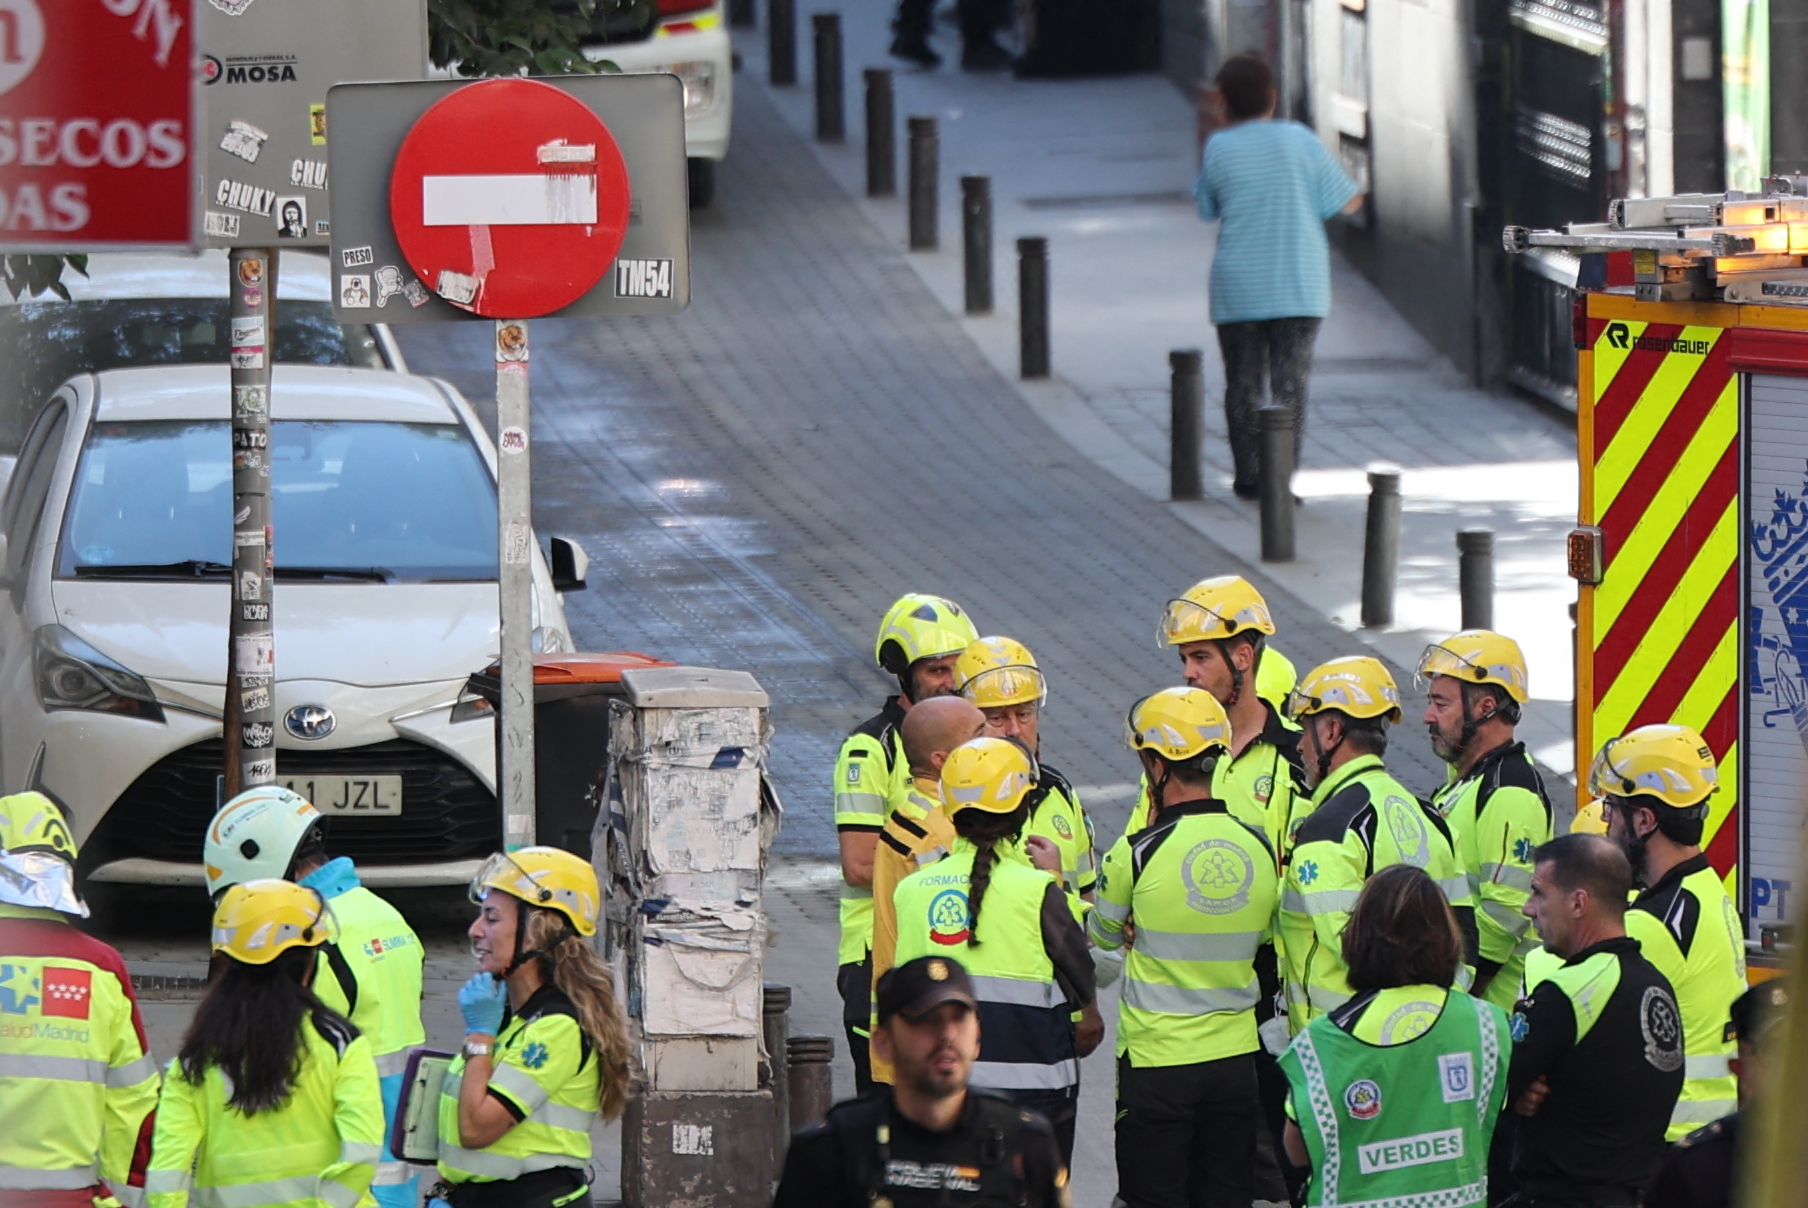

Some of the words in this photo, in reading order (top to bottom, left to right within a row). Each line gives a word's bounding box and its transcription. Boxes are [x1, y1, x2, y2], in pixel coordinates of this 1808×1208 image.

[102, 0, 184, 68] N
[226, 65, 298, 84] MOSA
[291, 159, 328, 191] CHU
[0, 182, 91, 232] AS
[217, 179, 276, 216] CHUKY
[344, 248, 372, 265] PRESO
[618, 259, 670, 297] TM54
[1632, 333, 1710, 355] rosenbauer
[234, 432, 267, 448] PATO
[333, 781, 390, 809] JZL
[919, 873, 970, 888] FORMAC
[1365, 1135, 1460, 1167] VERDES
